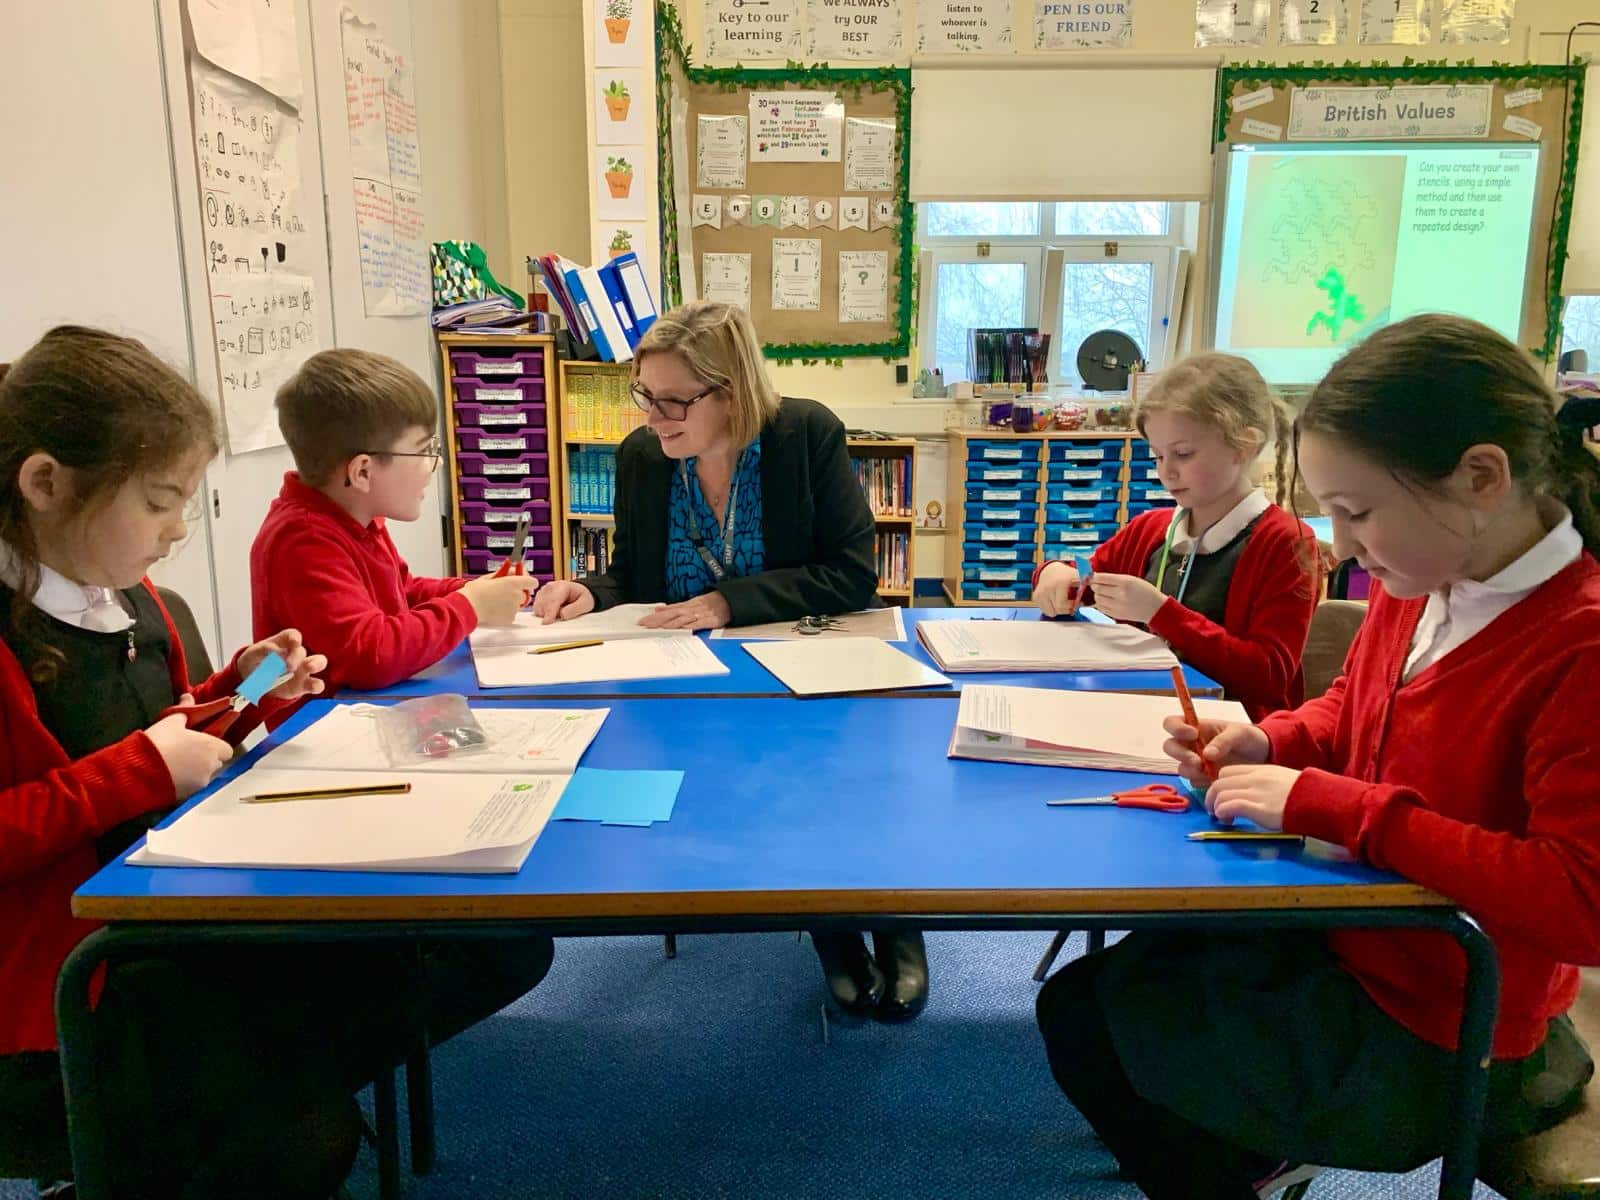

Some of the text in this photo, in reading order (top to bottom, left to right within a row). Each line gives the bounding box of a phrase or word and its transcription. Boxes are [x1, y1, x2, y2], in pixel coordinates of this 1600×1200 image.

[946, 4, 983, 13] listen to
[1043, 3, 1125, 15] PEN IS OUR
[1310, 0, 1319, 13] 2
[719, 12, 790, 26] Key to our
[834, 15, 878, 26] try OUR
[941, 18, 988, 27] whoever is
[1056, 21, 1111, 33] FRIEND
[725, 29, 783, 42] learning
[842, 32, 870, 42] BEST
[947, 32, 981, 42] talking.
[758, 99, 767, 108] 30
[1324, 102, 1456, 123] British Values
[1419, 161, 1521, 175] Can you create your own
[1454, 177, 1476, 189] using
[1485, 176, 1512, 190] simple
[1416, 191, 1502, 202] method and then use
[1415, 207, 1436, 217] them
[1438, 207, 1448, 217] to
[1450, 207, 1477, 217] create
[1412, 221, 1485, 234] repeated design?
[858, 271, 869, 286] ?
